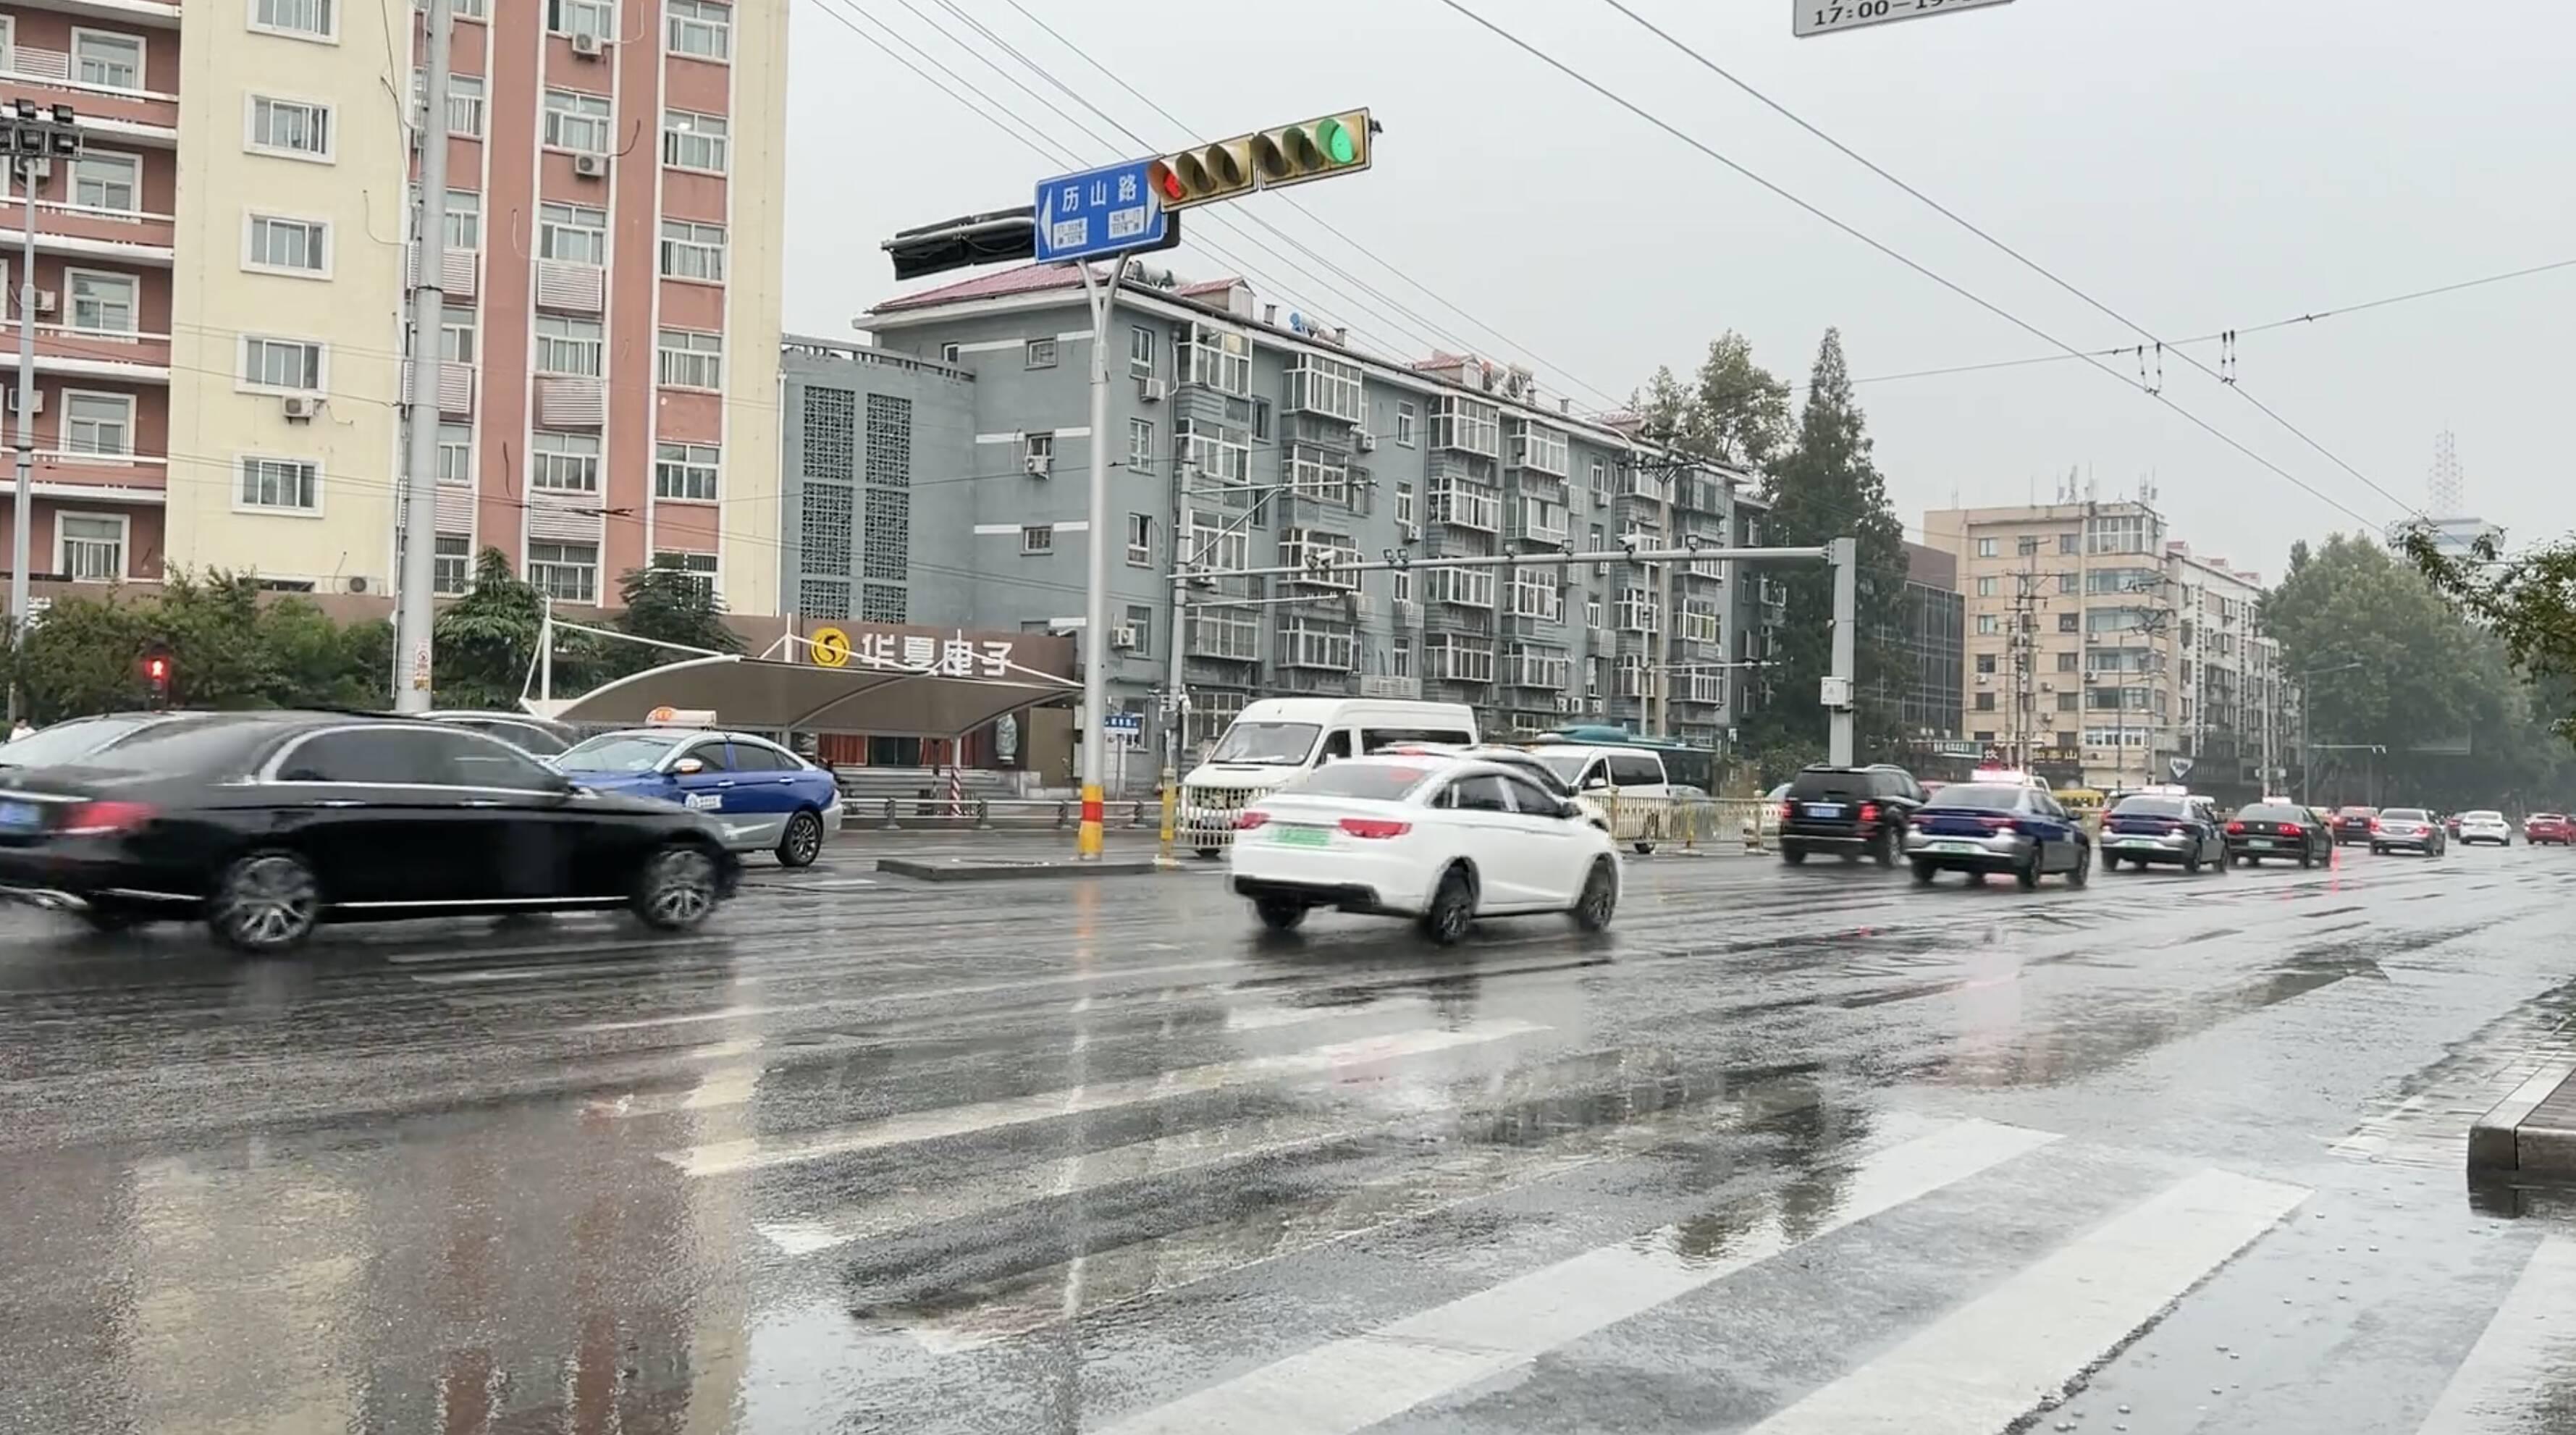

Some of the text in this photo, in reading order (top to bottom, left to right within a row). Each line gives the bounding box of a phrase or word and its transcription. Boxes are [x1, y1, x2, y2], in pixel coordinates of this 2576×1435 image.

[1062, 174, 1136, 212] 历山路
[862, 633, 1013, 676] 华夏电子
